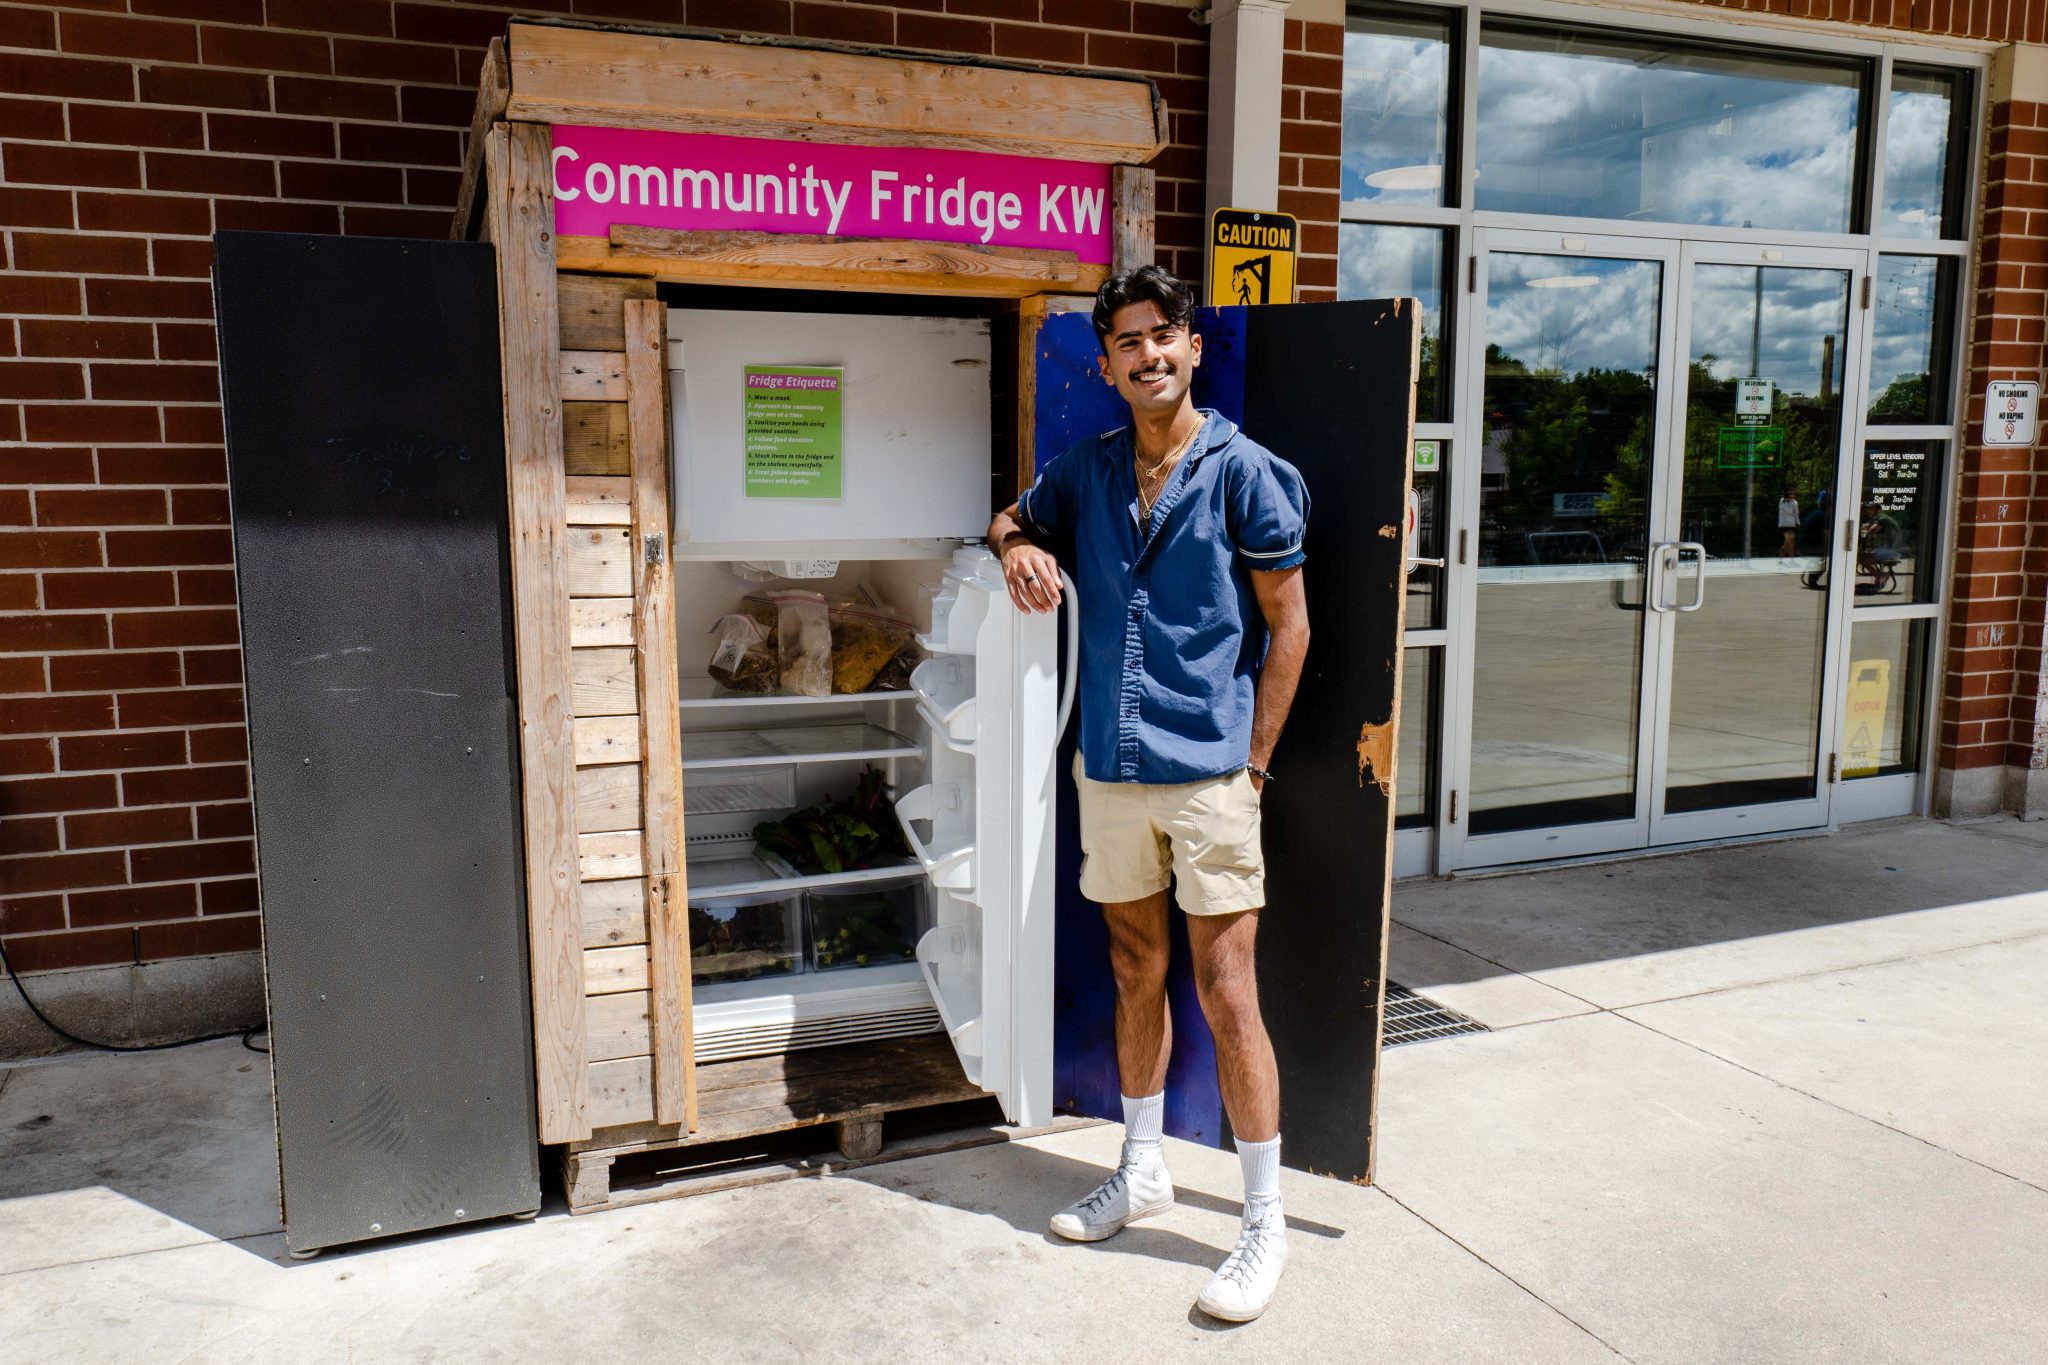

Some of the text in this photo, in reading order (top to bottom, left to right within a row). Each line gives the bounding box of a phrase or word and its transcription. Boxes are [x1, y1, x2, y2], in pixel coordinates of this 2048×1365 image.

[551, 147, 1105, 243] Community Fridge KW
[1218, 223, 1290, 248] CAUTION
[749, 376, 837, 389] Fridge Etiquette
[1878, 470, 1888, 478] Sat
